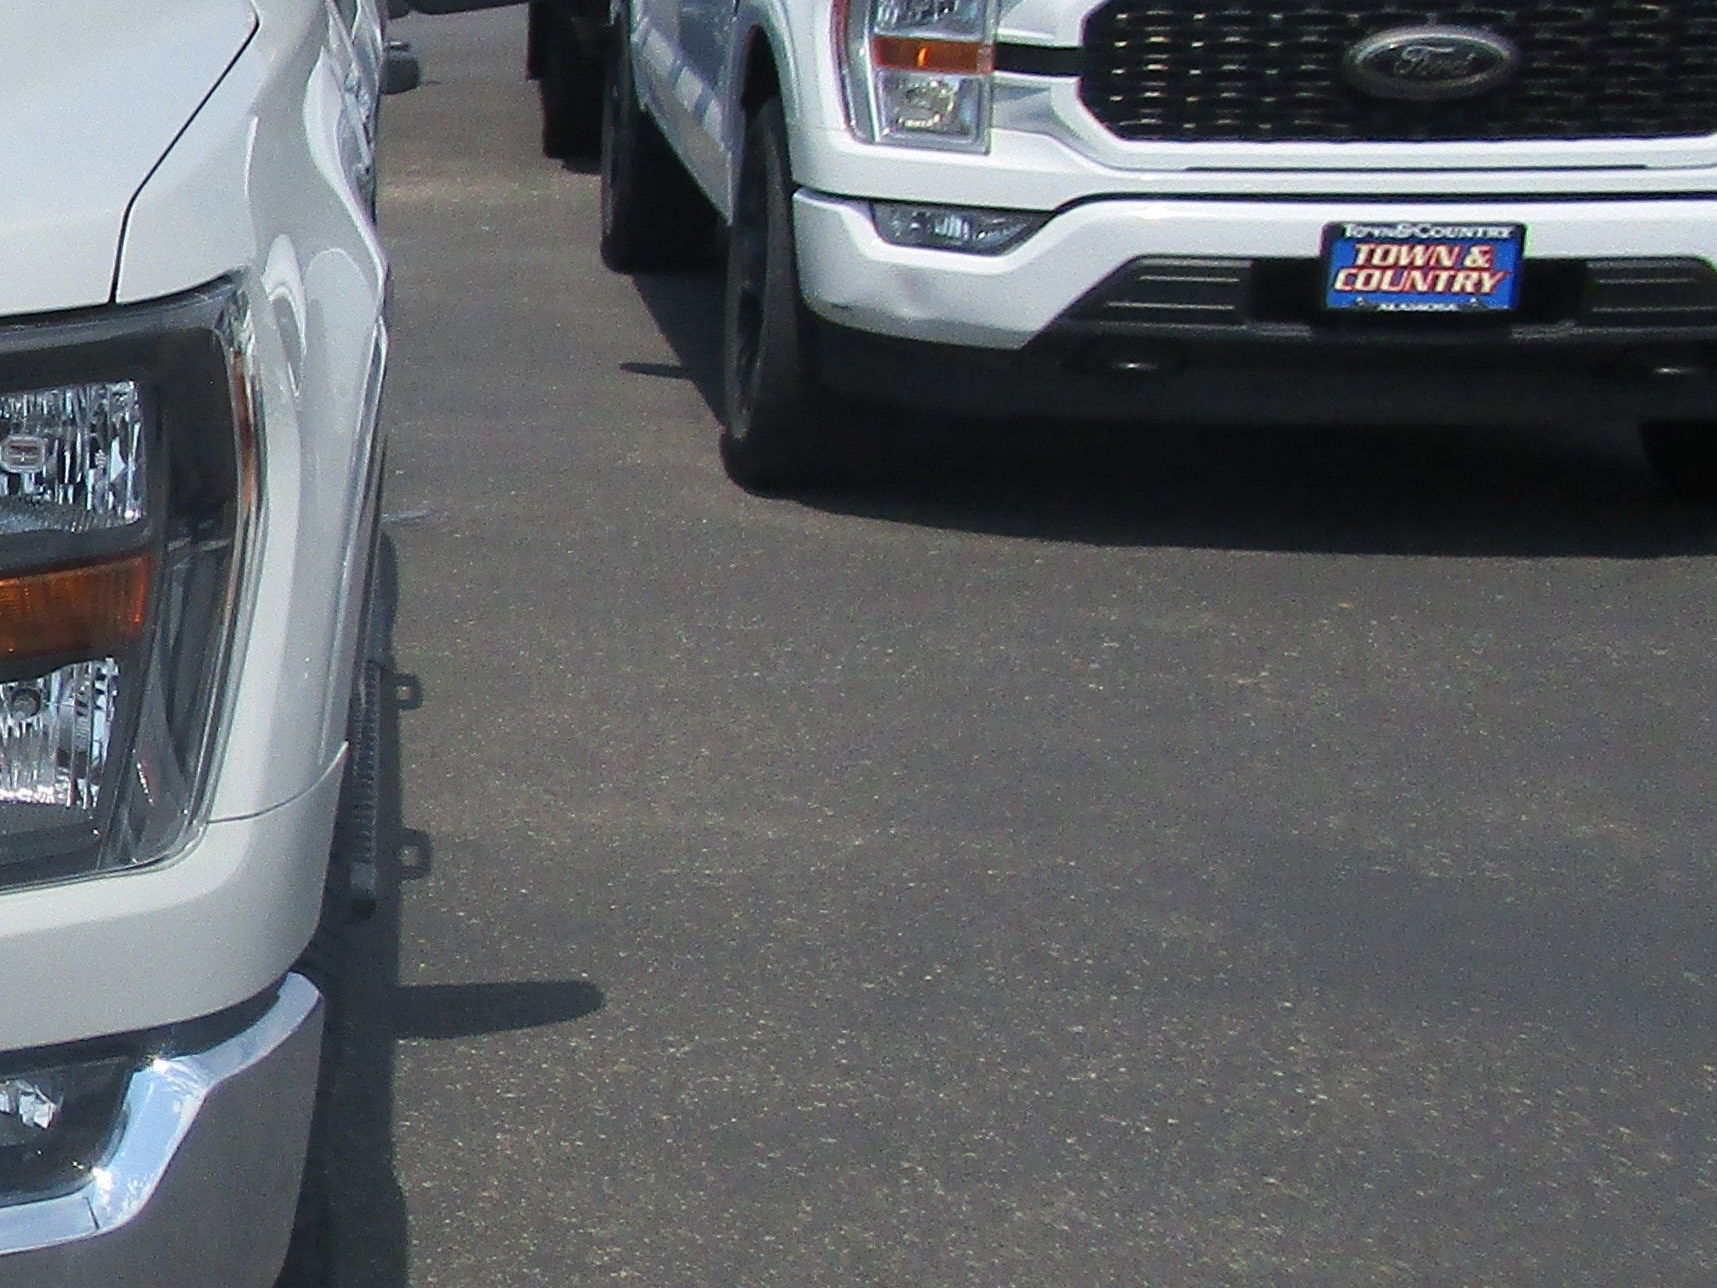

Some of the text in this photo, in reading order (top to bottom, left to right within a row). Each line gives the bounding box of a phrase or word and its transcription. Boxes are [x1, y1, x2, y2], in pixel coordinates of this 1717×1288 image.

[1353, 242, 1496, 270] TOWN &
[1333, 267, 1508, 295] COUNTRY
